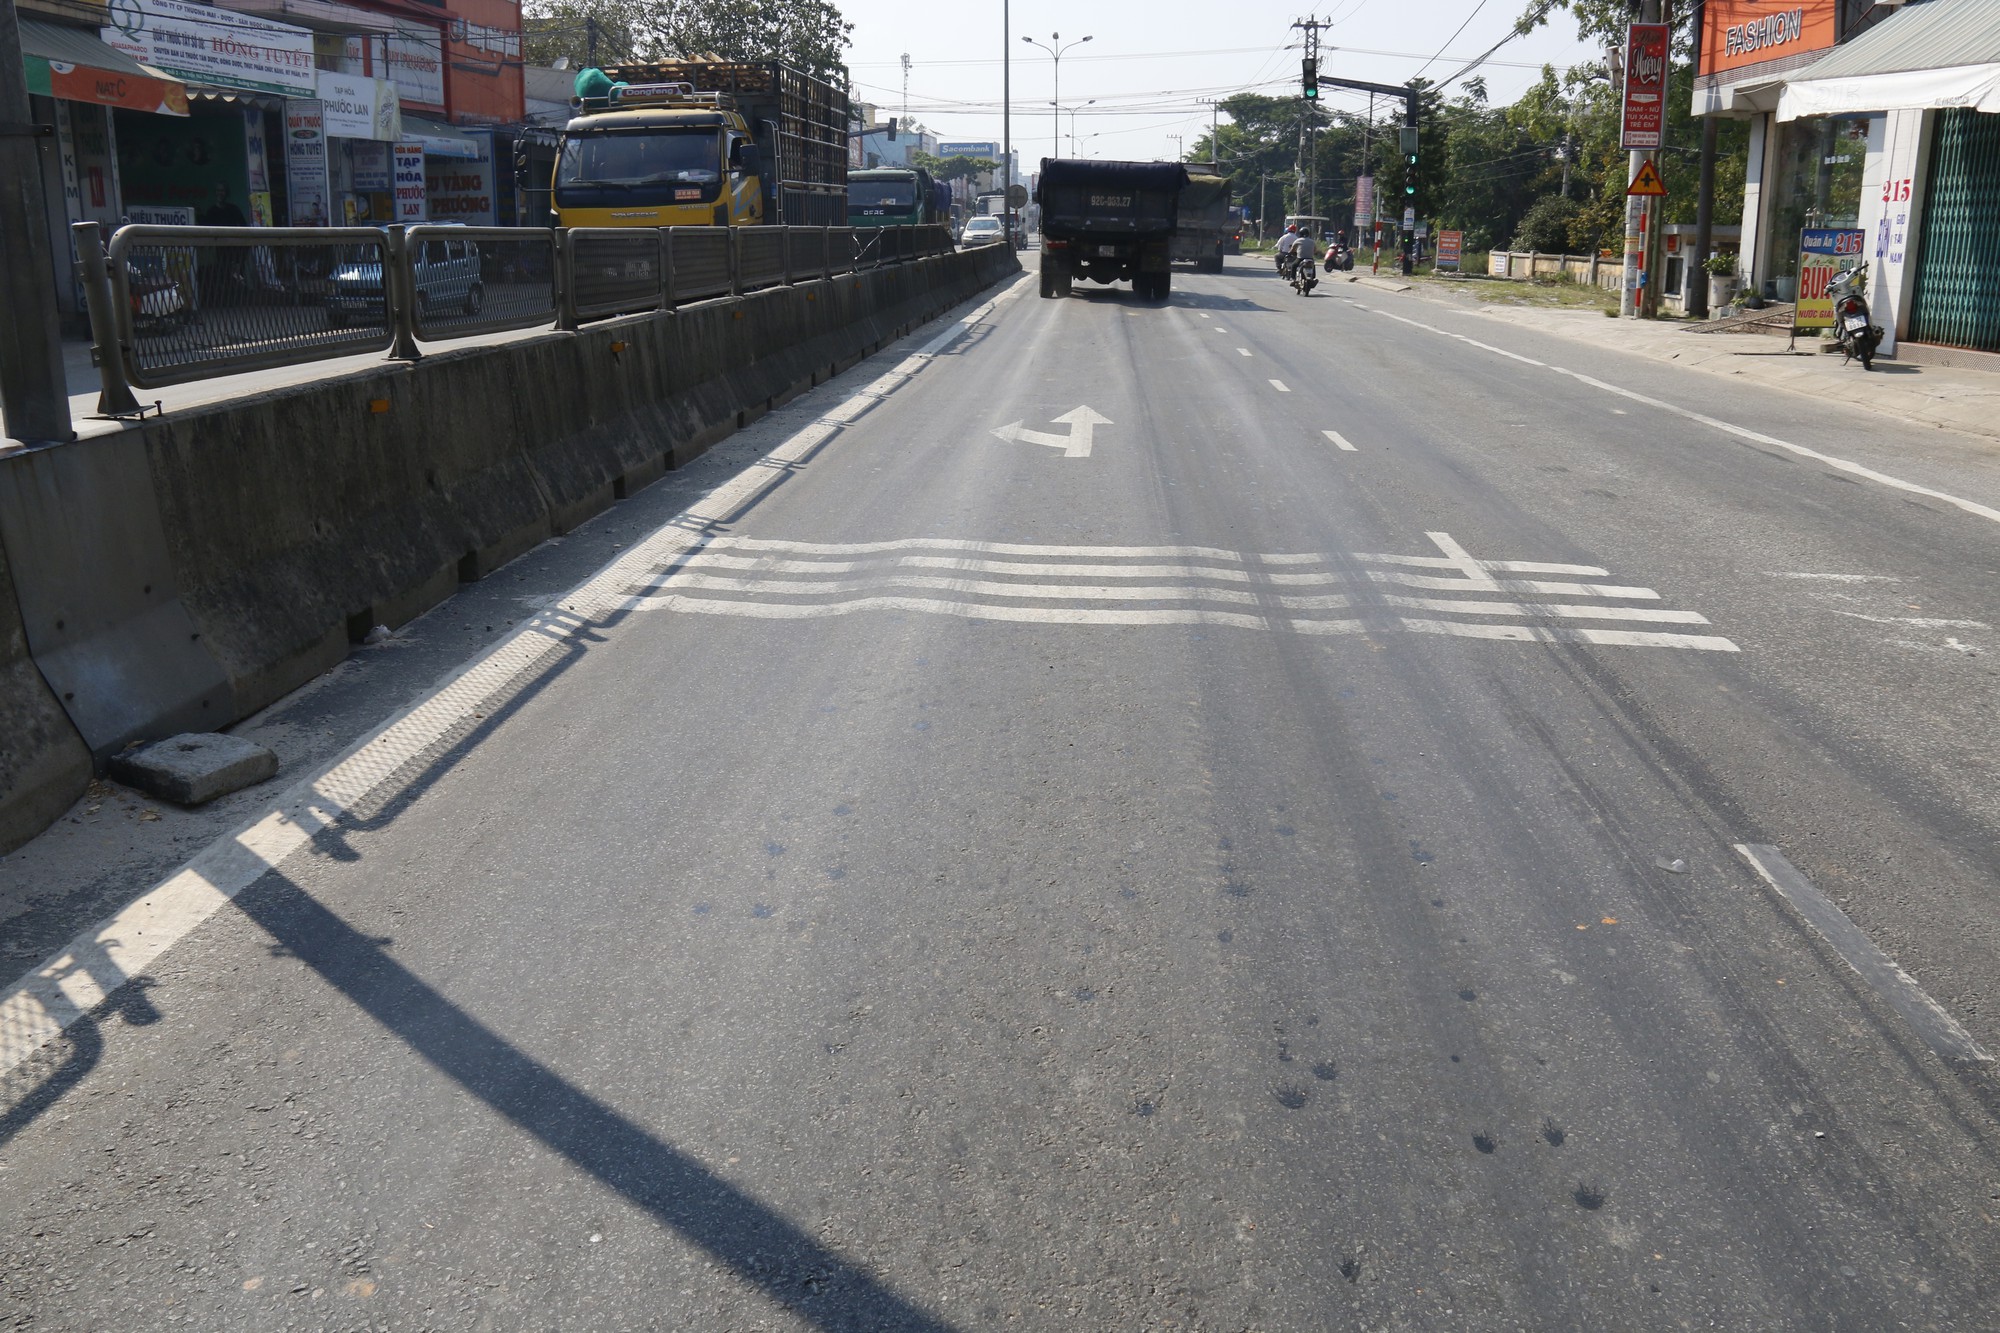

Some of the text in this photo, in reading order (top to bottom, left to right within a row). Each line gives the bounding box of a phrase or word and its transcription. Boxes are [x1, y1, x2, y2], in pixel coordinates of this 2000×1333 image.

[1725, 6, 1802, 57] FASHION
[211, 33, 259, 59] HỒNG
[264, 48, 311, 68] TUYẾT
[626, 88, 674, 96] Dongfeng
[324, 99, 352, 114] PHƯỚC
[354, 104, 369, 116] LAN
[942, 144, 990, 153] Sacombank
[396, 157, 420, 169] TẠP
[396, 185, 425, 199] PHƯỚC
[1882, 178, 1911, 202] 215
[403, 203, 420, 215] LAN
[1803, 233, 1863, 254] Quán Ăn 215
[1800, 260, 1833, 299] BÚN
[1798, 309, 1818, 318] NƯỚC
